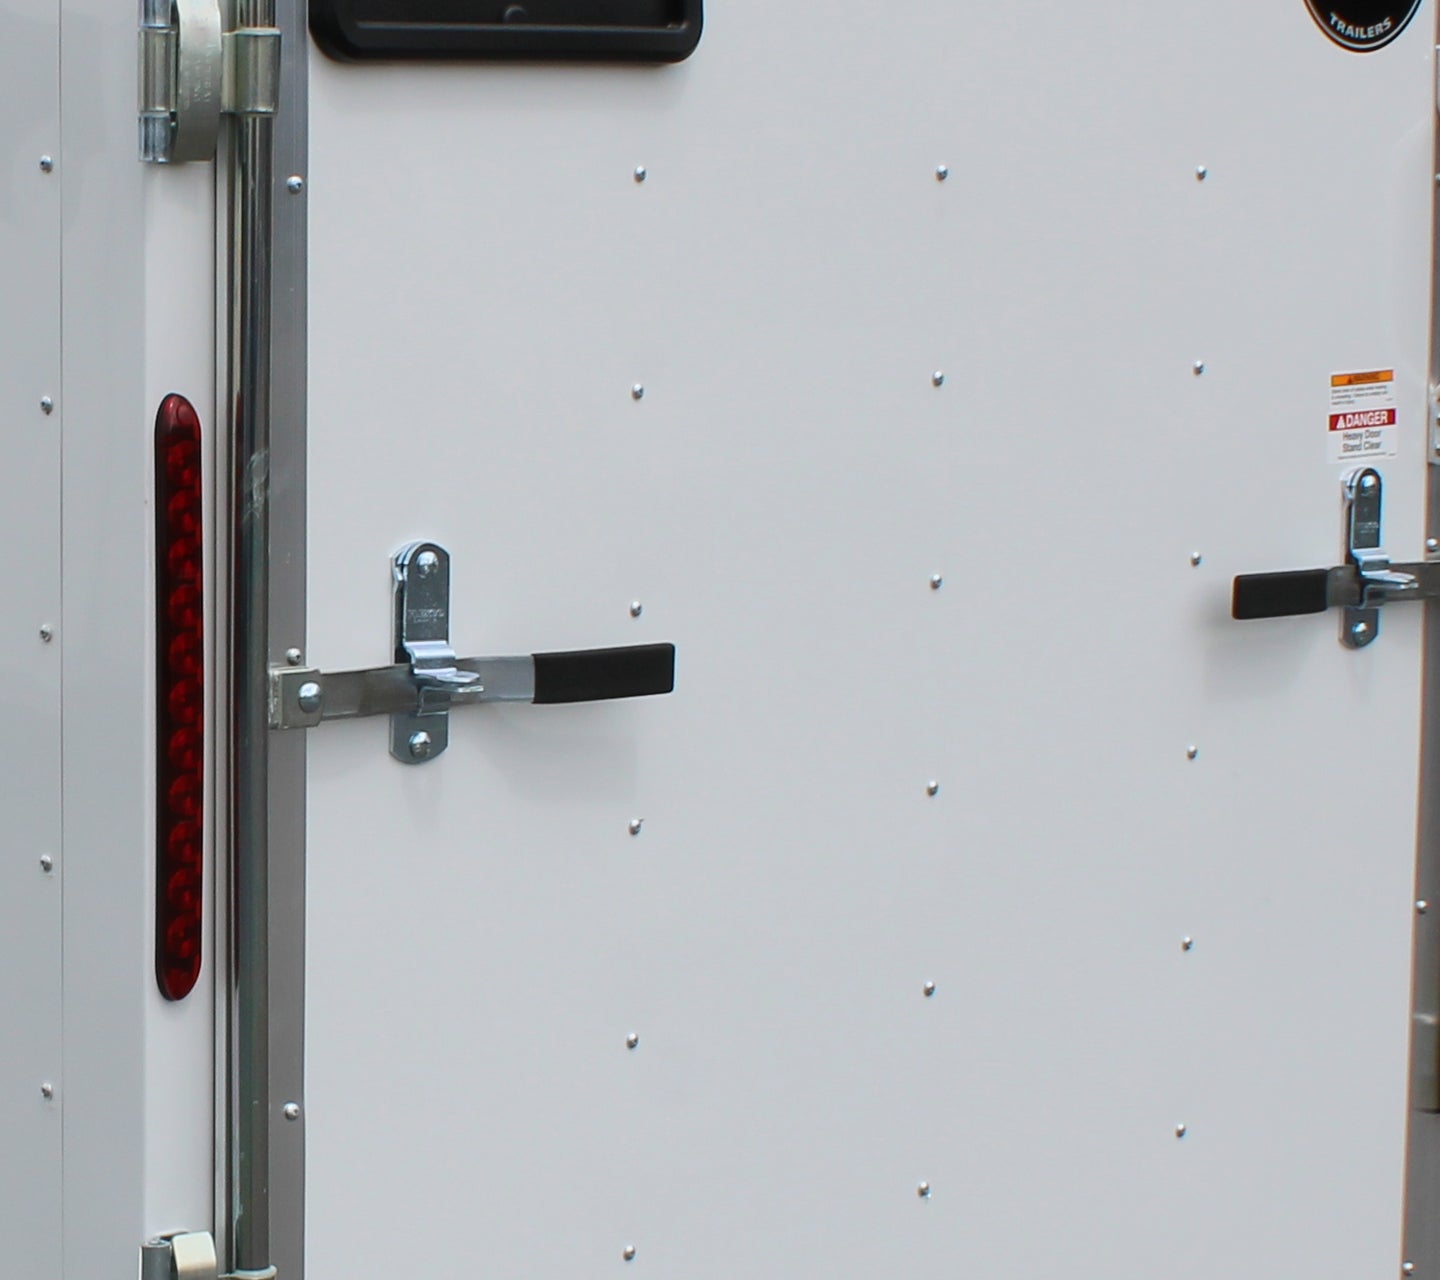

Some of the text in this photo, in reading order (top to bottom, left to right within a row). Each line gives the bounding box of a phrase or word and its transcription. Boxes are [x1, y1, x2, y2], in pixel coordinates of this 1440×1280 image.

[1328, 12, 1393, 40] TRAILERS
[1346, 410, 1388, 428] DANGER
[1342, 429, 1382, 442] Heavy Door
[1342, 441, 1382, 453] Stand Clear
